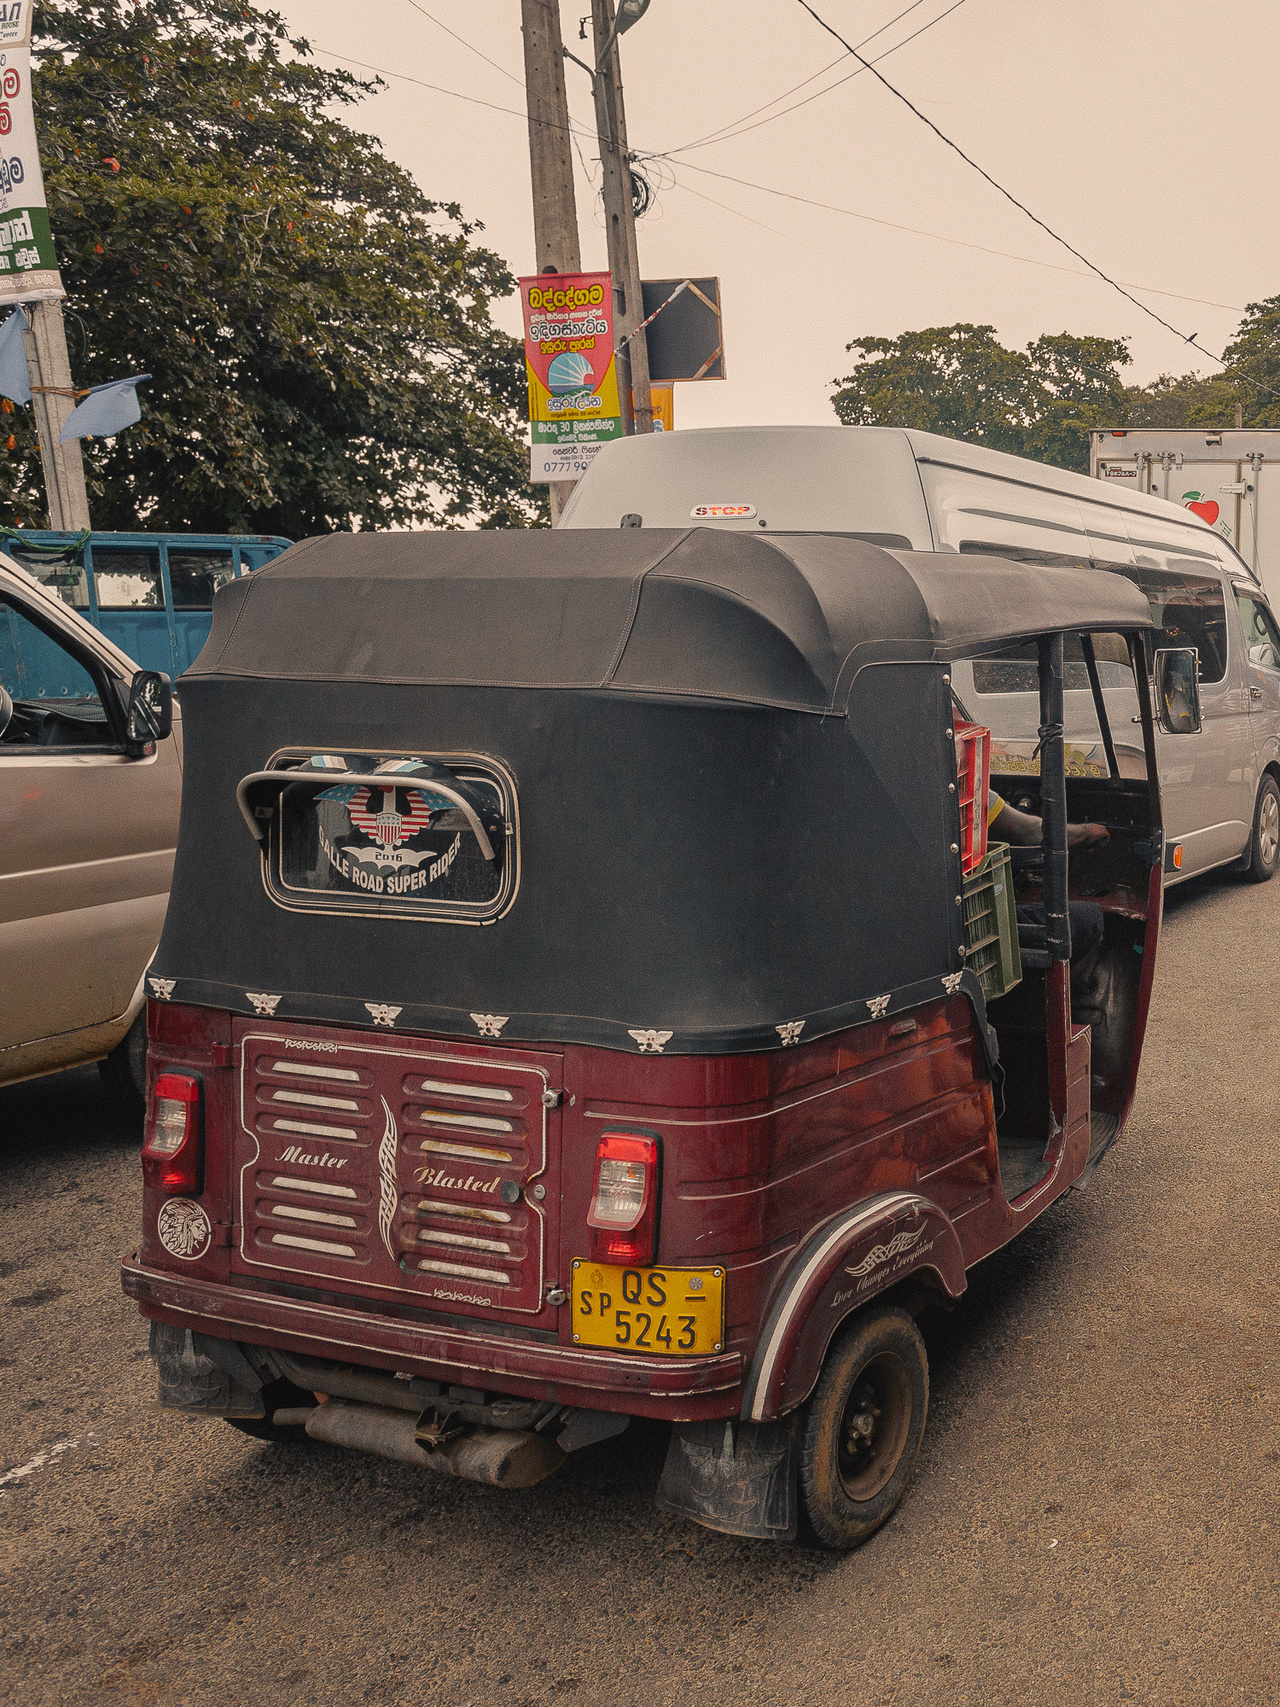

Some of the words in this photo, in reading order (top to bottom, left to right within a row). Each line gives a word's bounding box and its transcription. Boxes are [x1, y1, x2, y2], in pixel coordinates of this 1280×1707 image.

[529, 284, 604, 312] බද්දේගම
[560, 421, 570, 432] 30
[543, 462, 571, 473] 0777
[695, 506, 750, 515] STOP
[318, 824, 350, 879] GALLE
[352, 866, 384, 894] ROAD
[386, 869, 427, 894] SUPER
[429, 831, 461, 883] RIDER
[375, 851, 403, 862] 2016
[275, 1145, 348, 1169] Master
[413, 1166, 501, 1194] Blasted
[856, 1266, 890, 1293] Changes
[893, 1240, 934, 1271] Everything
[622, 1270, 667, 1307] QS
[580, 1290, 612, 1316] SP
[615, 1310, 696, 1349] 5243
